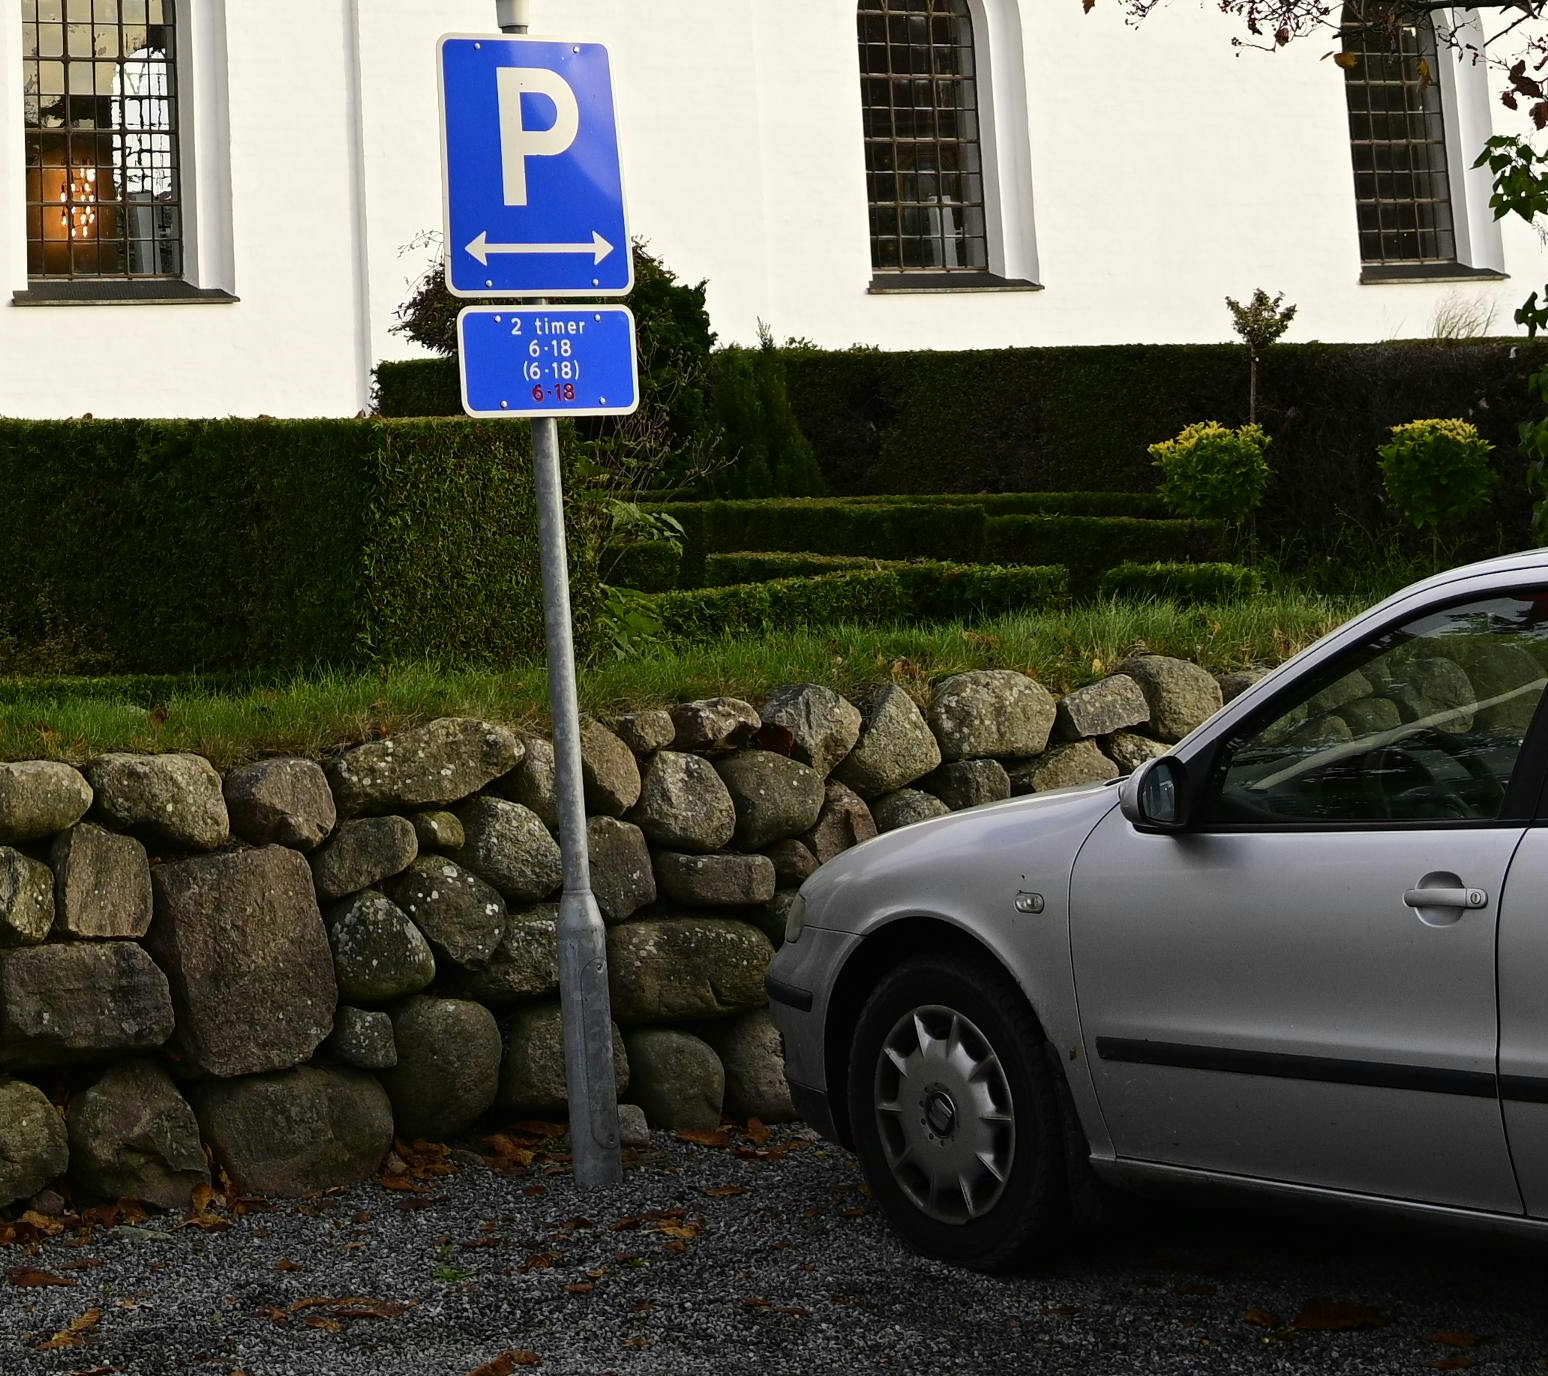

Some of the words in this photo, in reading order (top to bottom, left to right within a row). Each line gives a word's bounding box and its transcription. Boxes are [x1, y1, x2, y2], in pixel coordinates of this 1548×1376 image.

[495, 66, 579, 206] P
[510, 317, 522, 335] 2
[535, 317, 585, 335] timer
